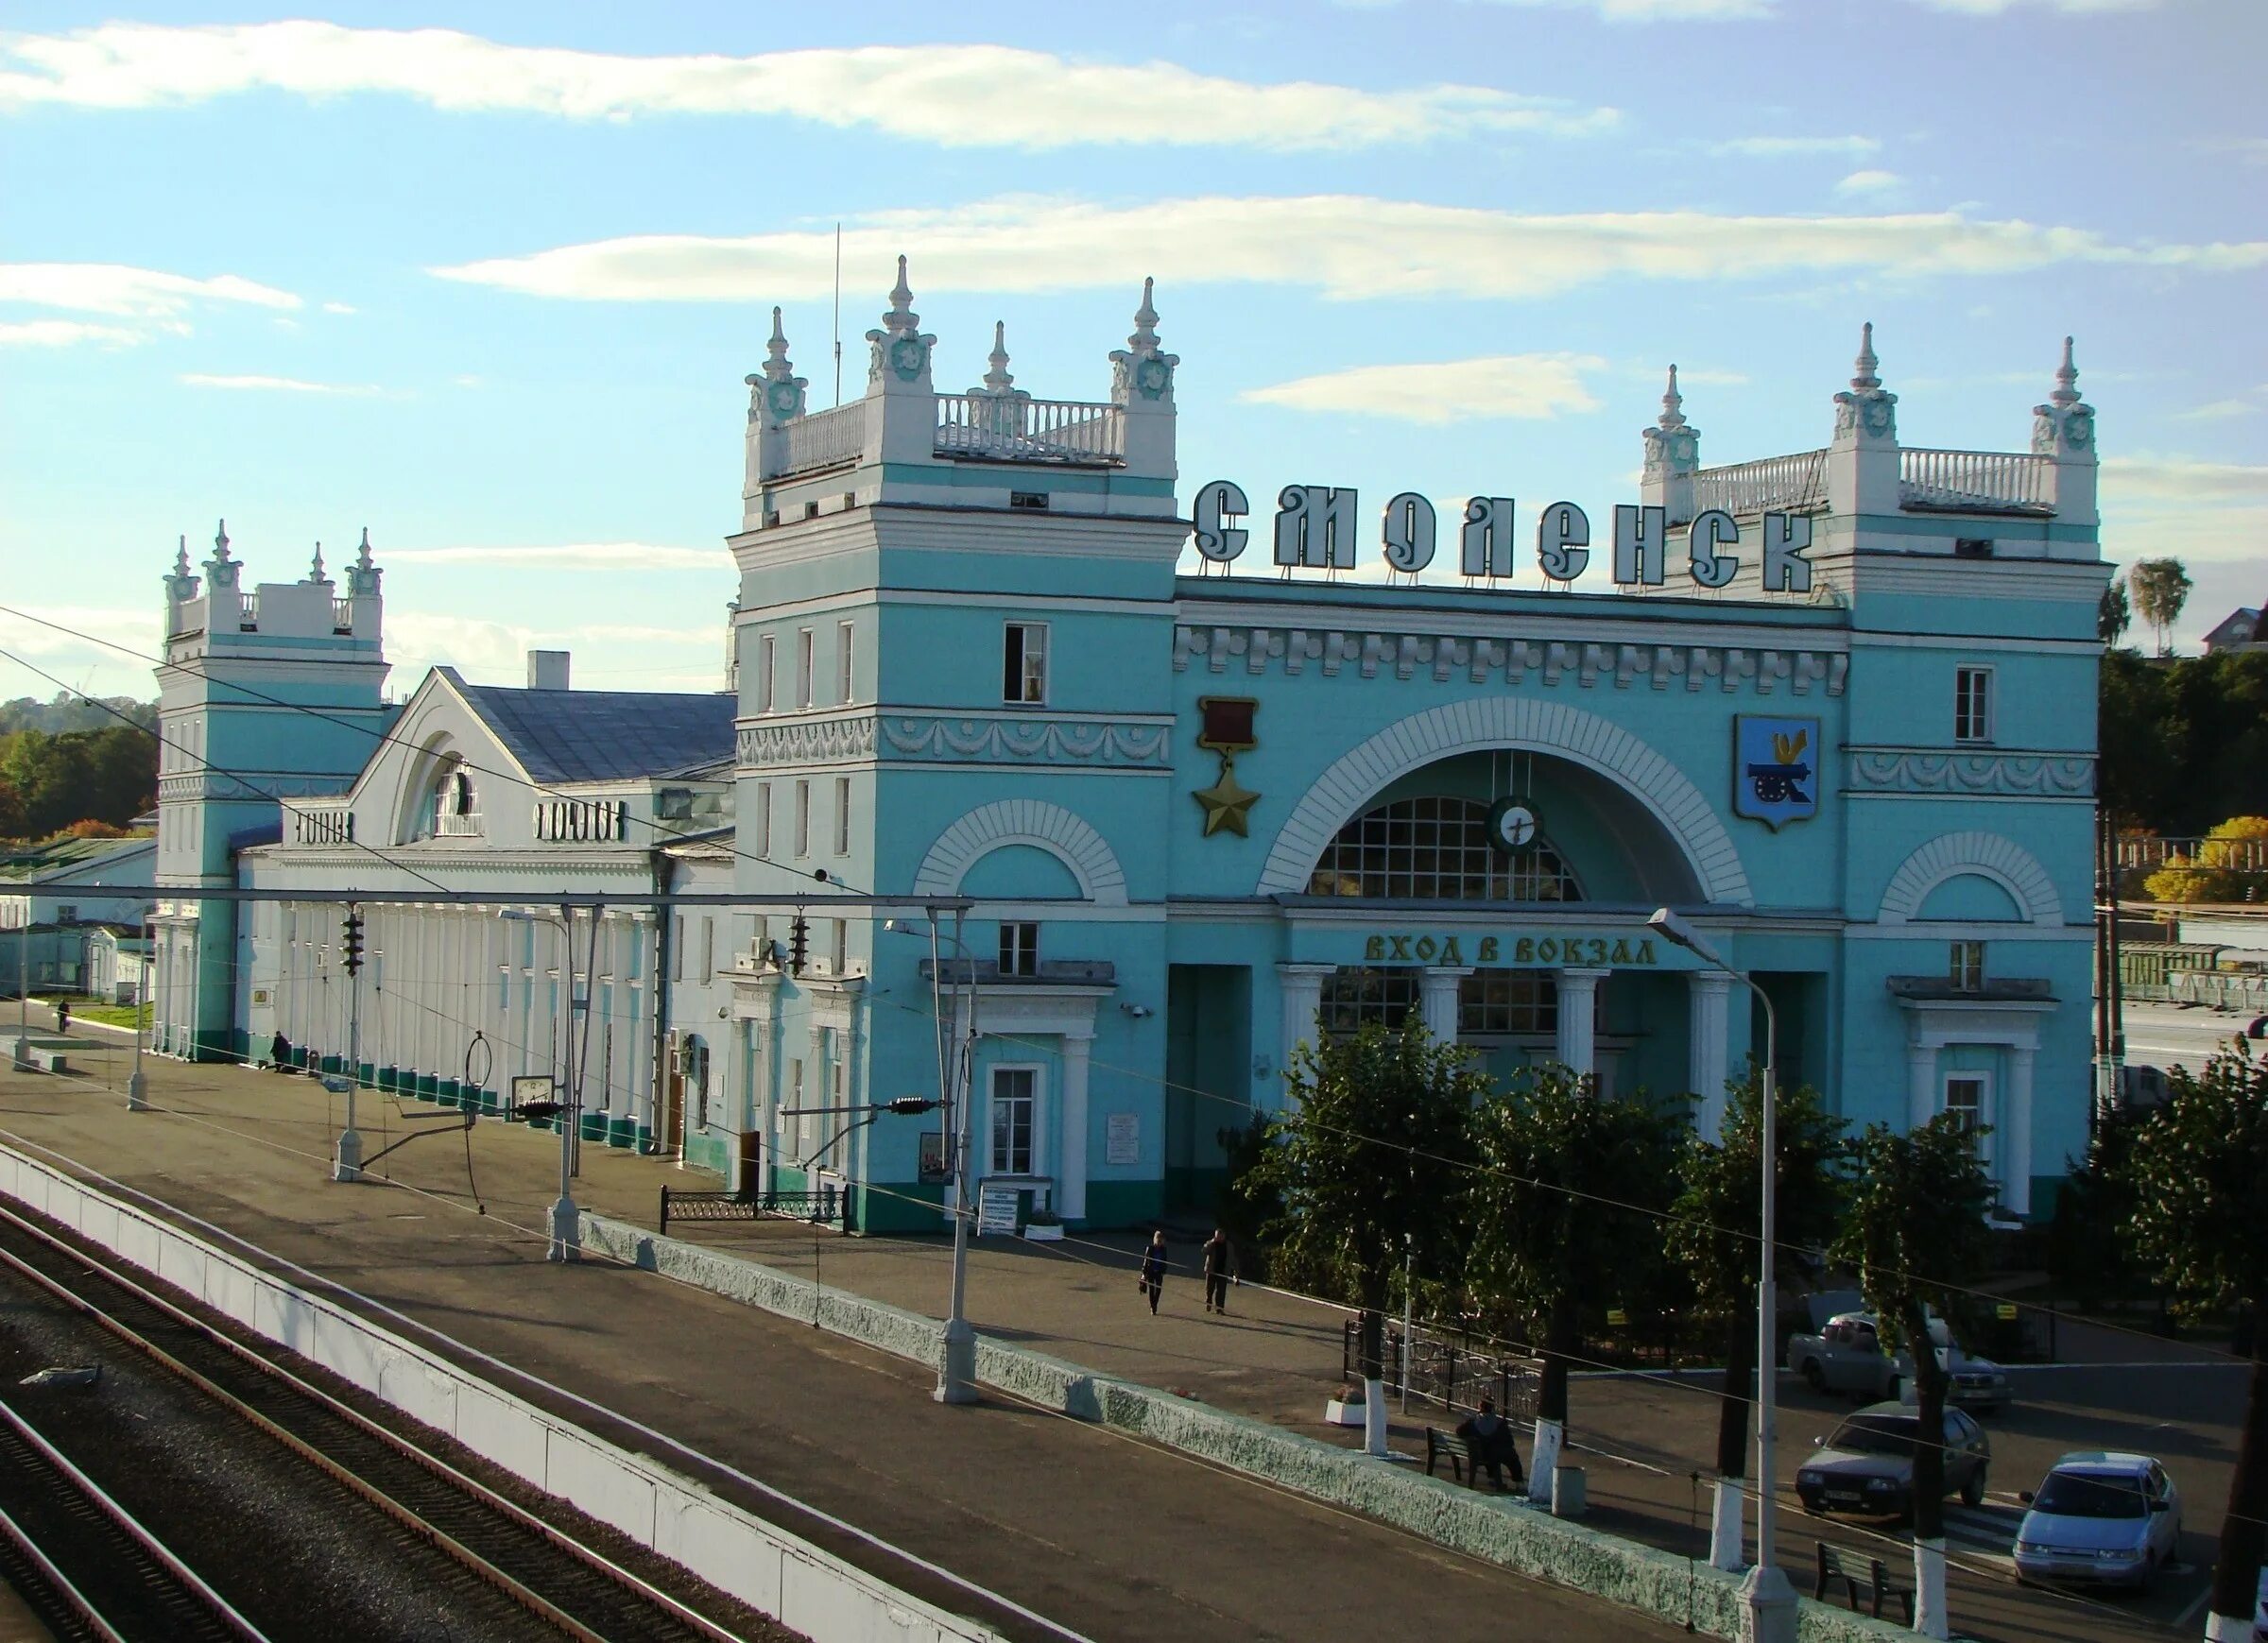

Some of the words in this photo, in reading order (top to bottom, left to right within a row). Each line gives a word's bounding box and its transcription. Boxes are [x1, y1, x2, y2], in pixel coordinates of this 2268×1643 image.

[1193, 479, 1813, 594] СМОЛЕНСК
[1364, 934, 1463, 967] ВХОД
[1477, 935, 1499, 962] В
[1514, 935, 1658, 967] ВОКЗАЛ
